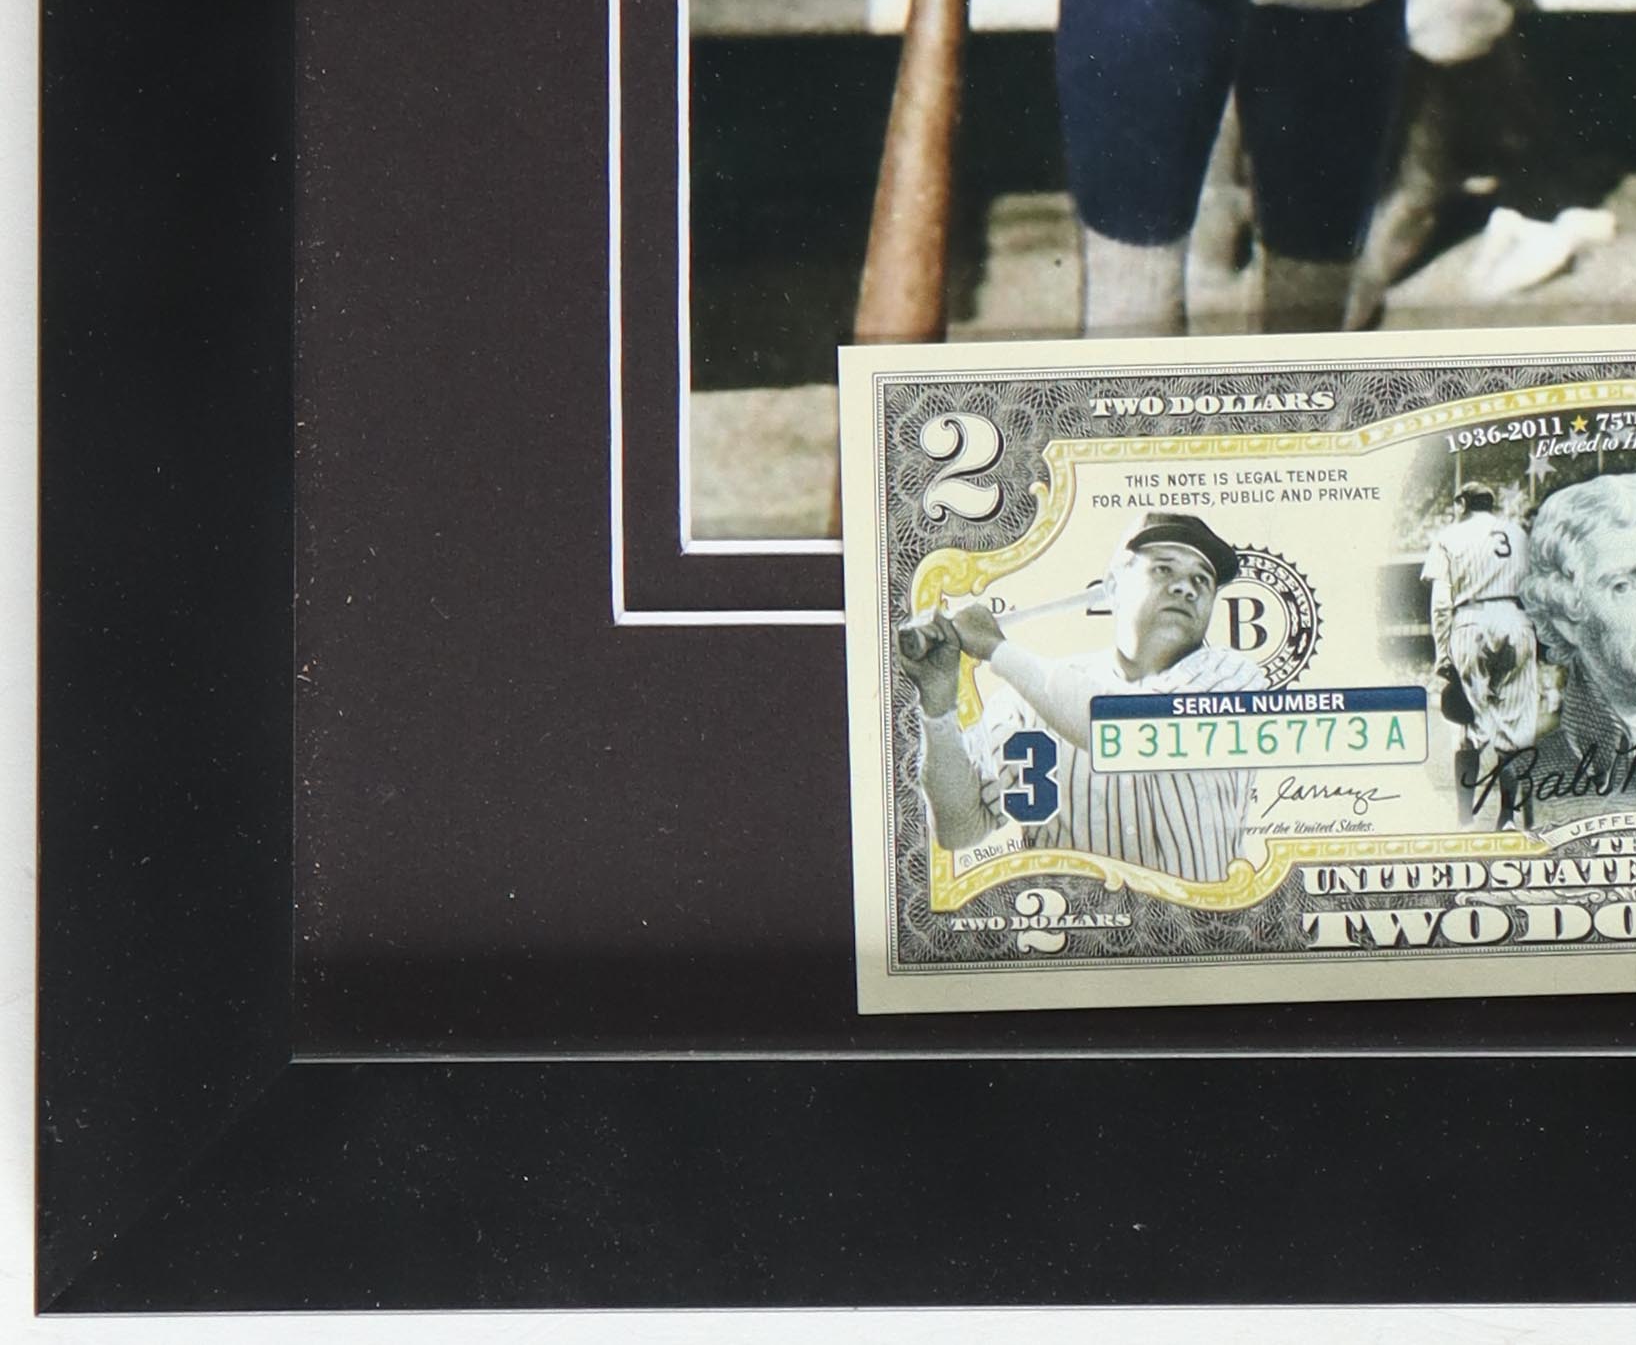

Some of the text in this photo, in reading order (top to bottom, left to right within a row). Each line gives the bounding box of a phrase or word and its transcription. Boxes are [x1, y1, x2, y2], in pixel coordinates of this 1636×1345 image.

[1090, 391, 1337, 418] TWO DOLLARS
[1445, 415, 1563, 454] 1936-2011
[1535, 432, 1601, 459] Elected
[1602, 432, 1618, 451] to
[919, 412, 1006, 524] 2
[1125, 469, 1349, 488] THIS NOTE IS LEGAL TENDER
[1092, 486, 1381, 508] FOR ALL DEBTS, PUBLIC AND PRIVATE
[1490, 531, 1512, 558] 3
[1222, 596, 1268, 652] B
[1172, 693, 1345, 715] SERIAL NUMBER
[1001, 729, 1061, 825] 3
[1272, 820, 1290, 835] the
[1294, 819, 1334, 834] United
[1336, 818, 1375, 834] States.
[1300, 861, 1490, 896] UNITED
[951, 911, 1133, 932] TWO DOLLARS
[1302, 905, 1515, 950] TWO
